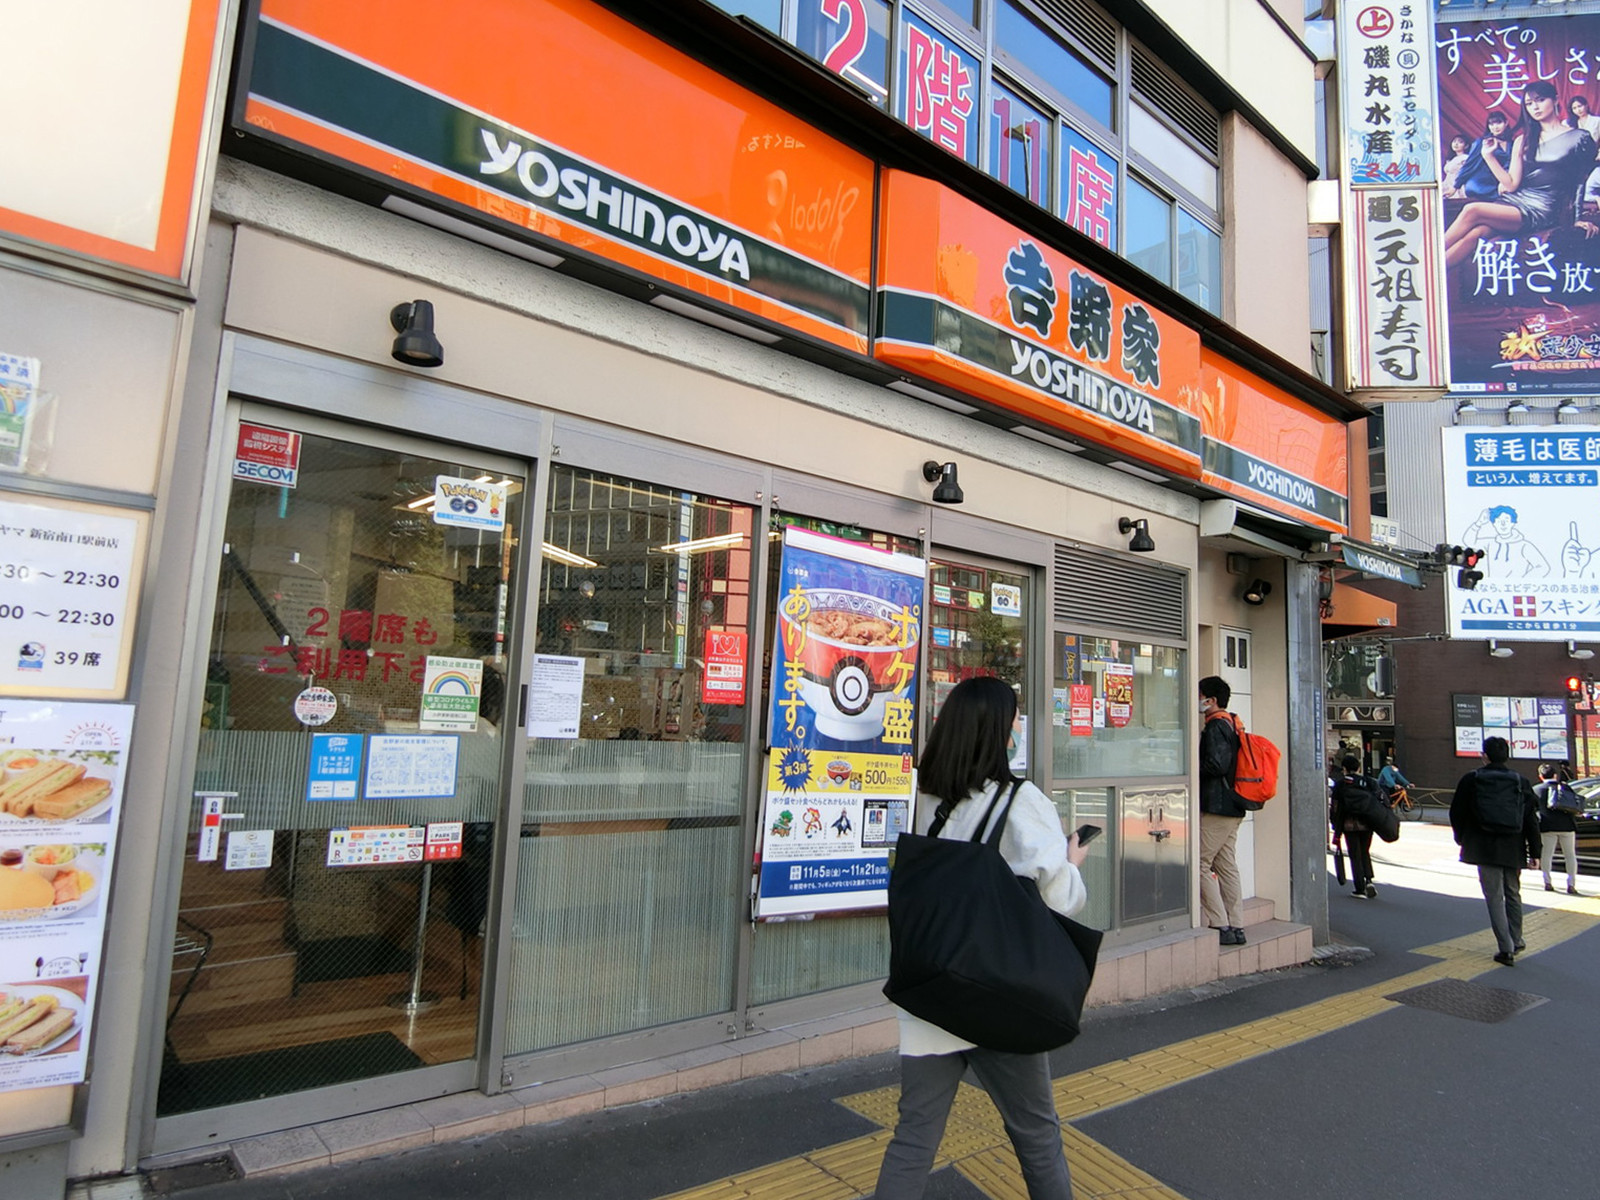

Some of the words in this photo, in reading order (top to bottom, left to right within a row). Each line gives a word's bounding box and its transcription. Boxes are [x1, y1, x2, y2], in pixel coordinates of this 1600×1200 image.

[1436, 25, 1537, 75] すべての
[1483, 48, 1600, 109] 美しさ
[1363, 45, 1393, 154] 磯丸水産
[479, 128, 751, 281] YOSHINOYA
[1368, 196, 1420, 223] 廻る
[1472, 237, 1600, 296] 解き放
[1003, 239, 1161, 390] 吉野家
[1371, 229, 1423, 381] 元祖寿司
[1010, 338, 1155, 433] YOSHINOYA
[238, 461, 293, 482] SECOM
[1247, 460, 1316, 509] YOSHINOYA
[63, 570, 120, 588] 22:30
[1357, 553, 1403, 580] YOSHINOYA
[58, 609, 114, 626] 22:30
[1461, 598, 1510, 615] AGA
[779, 584, 811, 738] あります。
[882, 604, 919, 744] ポケ盛
